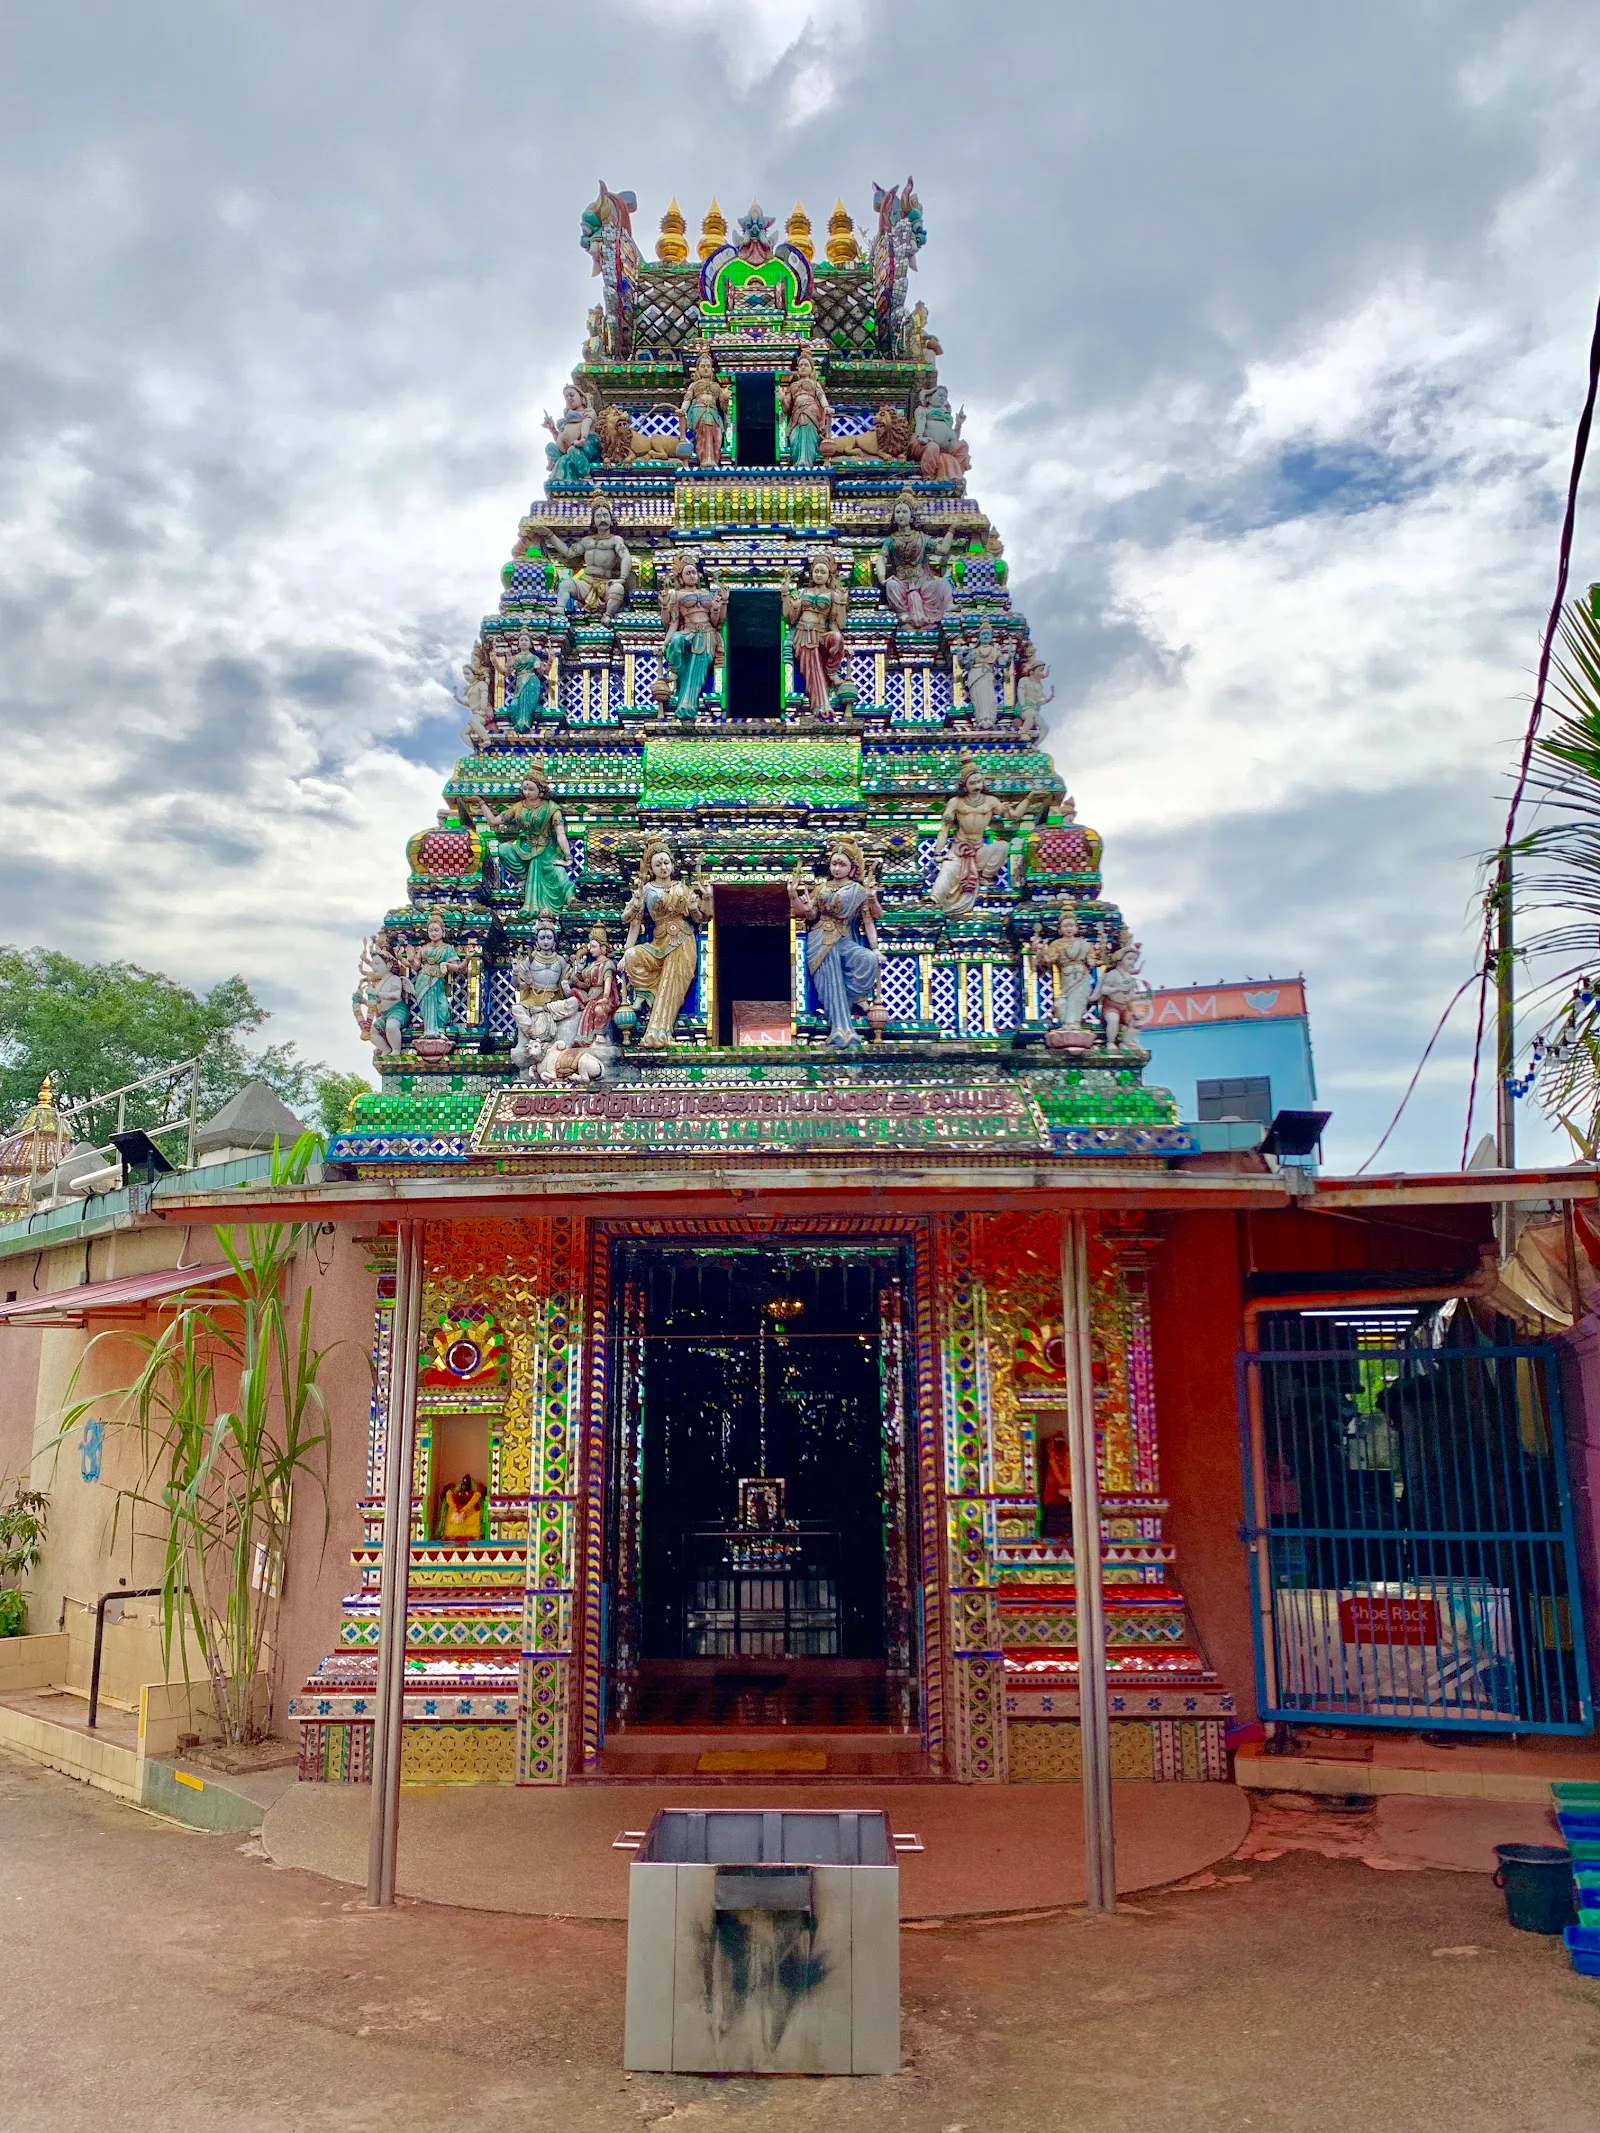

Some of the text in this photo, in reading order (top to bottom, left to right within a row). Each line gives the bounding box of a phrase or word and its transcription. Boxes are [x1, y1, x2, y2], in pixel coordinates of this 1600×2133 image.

[490, 1116, 1031, 1142] ARULMIGU SRI RAJA KALIAMMAN GLASS TEMPLE
[1392, 1606, 1429, 1621] Rack
